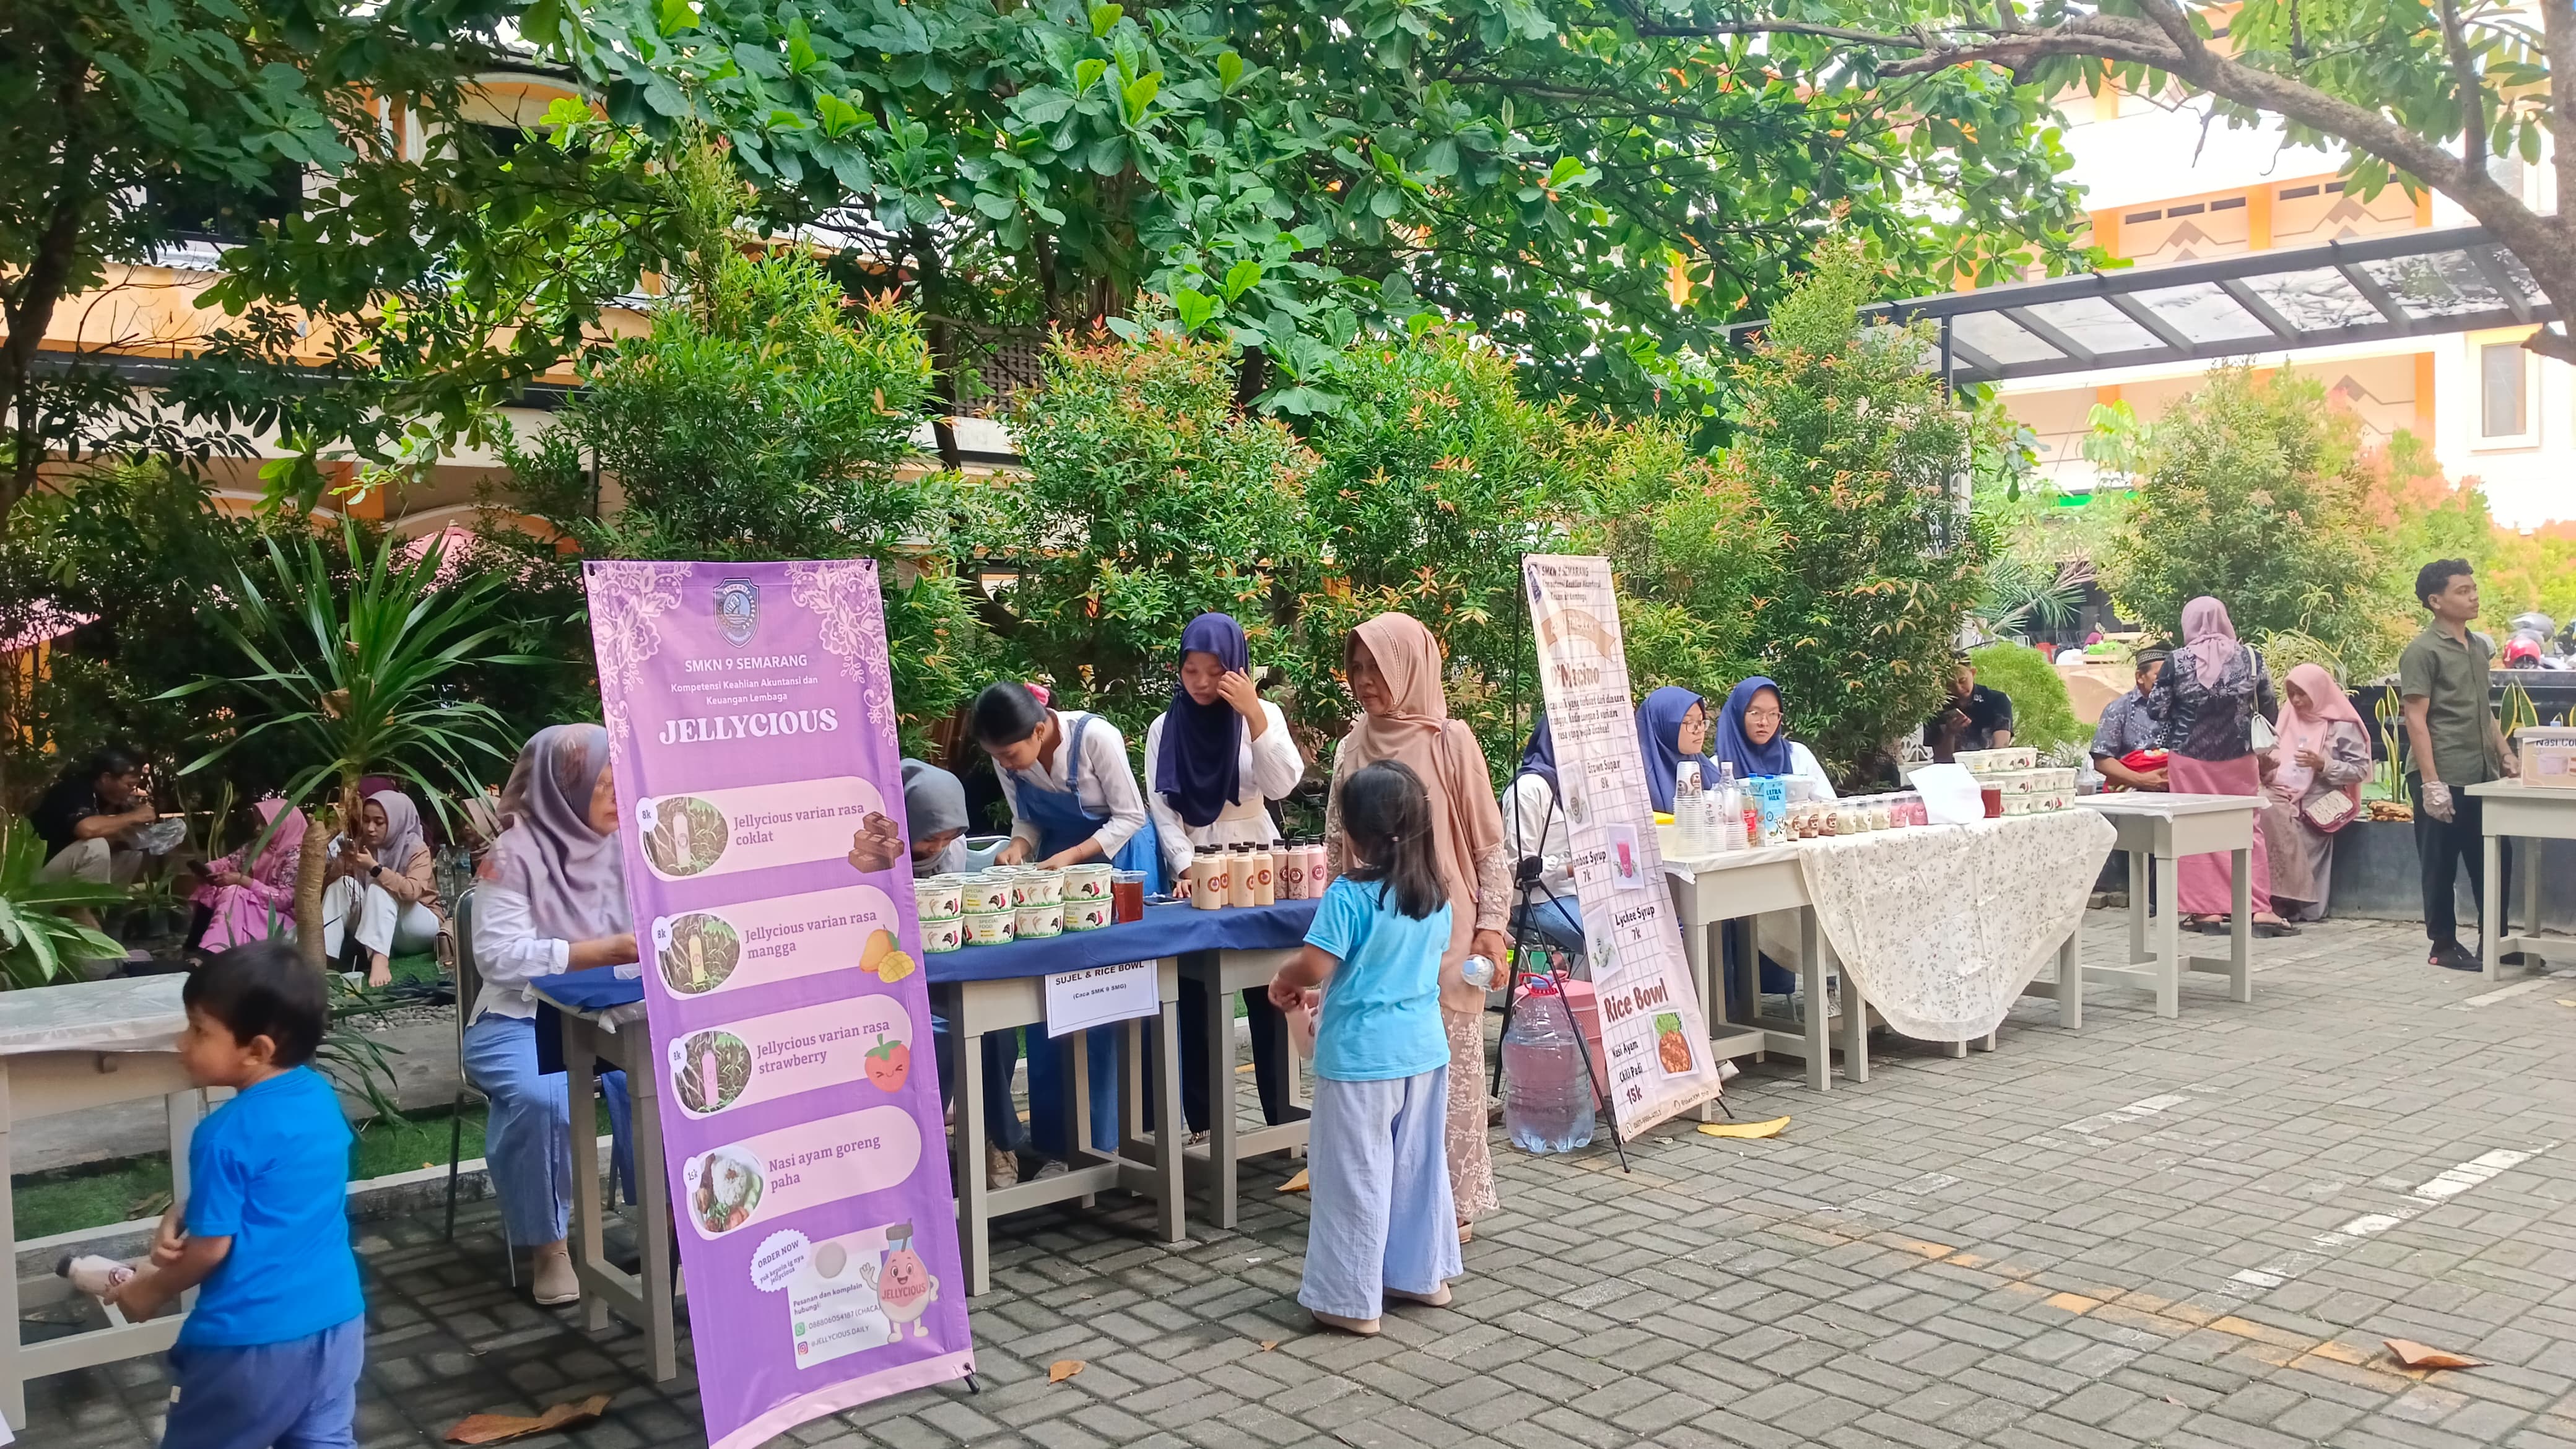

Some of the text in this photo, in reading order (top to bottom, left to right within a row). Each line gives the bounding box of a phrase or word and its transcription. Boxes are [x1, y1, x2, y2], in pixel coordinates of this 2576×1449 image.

[685, 655, 807, 672] SMKN 9 SEMARANG
[671, 676, 818, 694] Kompetensi Keahlian Akuntansi dan
[707, 692, 788, 706] Keuangan Lembaga
[1606, 694, 1625, 703] daun
[659, 708, 838, 744] JELLYCIOUS
[1604, 759, 1620, 773] Sugar
[1601, 777, 1609, 789] 8k
[642, 809, 651, 820] 8k
[733, 804, 864, 830] Jellycious varian rasa
[736, 830, 773, 846] coklat
[1590, 850, 1606, 865] Syrup
[1583, 869, 1591, 882] 7k
[1614, 905, 1655, 928] Lychee Syrup
[657, 929, 666, 939] 8k
[744, 911, 877, 944] Jellycious varian rasa
[1631, 927, 1641, 940] 7k
[747, 941, 797, 960] mangga
[1056, 973, 1082, 985] SUJEL
[1095, 965, 1115, 977] RICE
[1118, 961, 1144, 972] BOWL
[1604, 977, 1669, 1023] Rice Bowl
[756, 1020, 890, 1060] Jellycious varian rasa
[1623, 1040, 1638, 1055] Ayam
[673, 1051, 681, 1061] 8k
[758, 1050, 828, 1074] strawberry
[1630, 1063, 1643, 1077] Padi
[1626, 1084, 1643, 1105] 15k
[768, 1135, 881, 1172] Nasi ayam goreng
[770, 1172, 801, 1194] paha
[758, 1240, 798, 1268] ORDER NOW
[793, 1283, 863, 1307] Pesanan dan komplain
[882, 1283, 926, 1300] JELLYCIOUS
